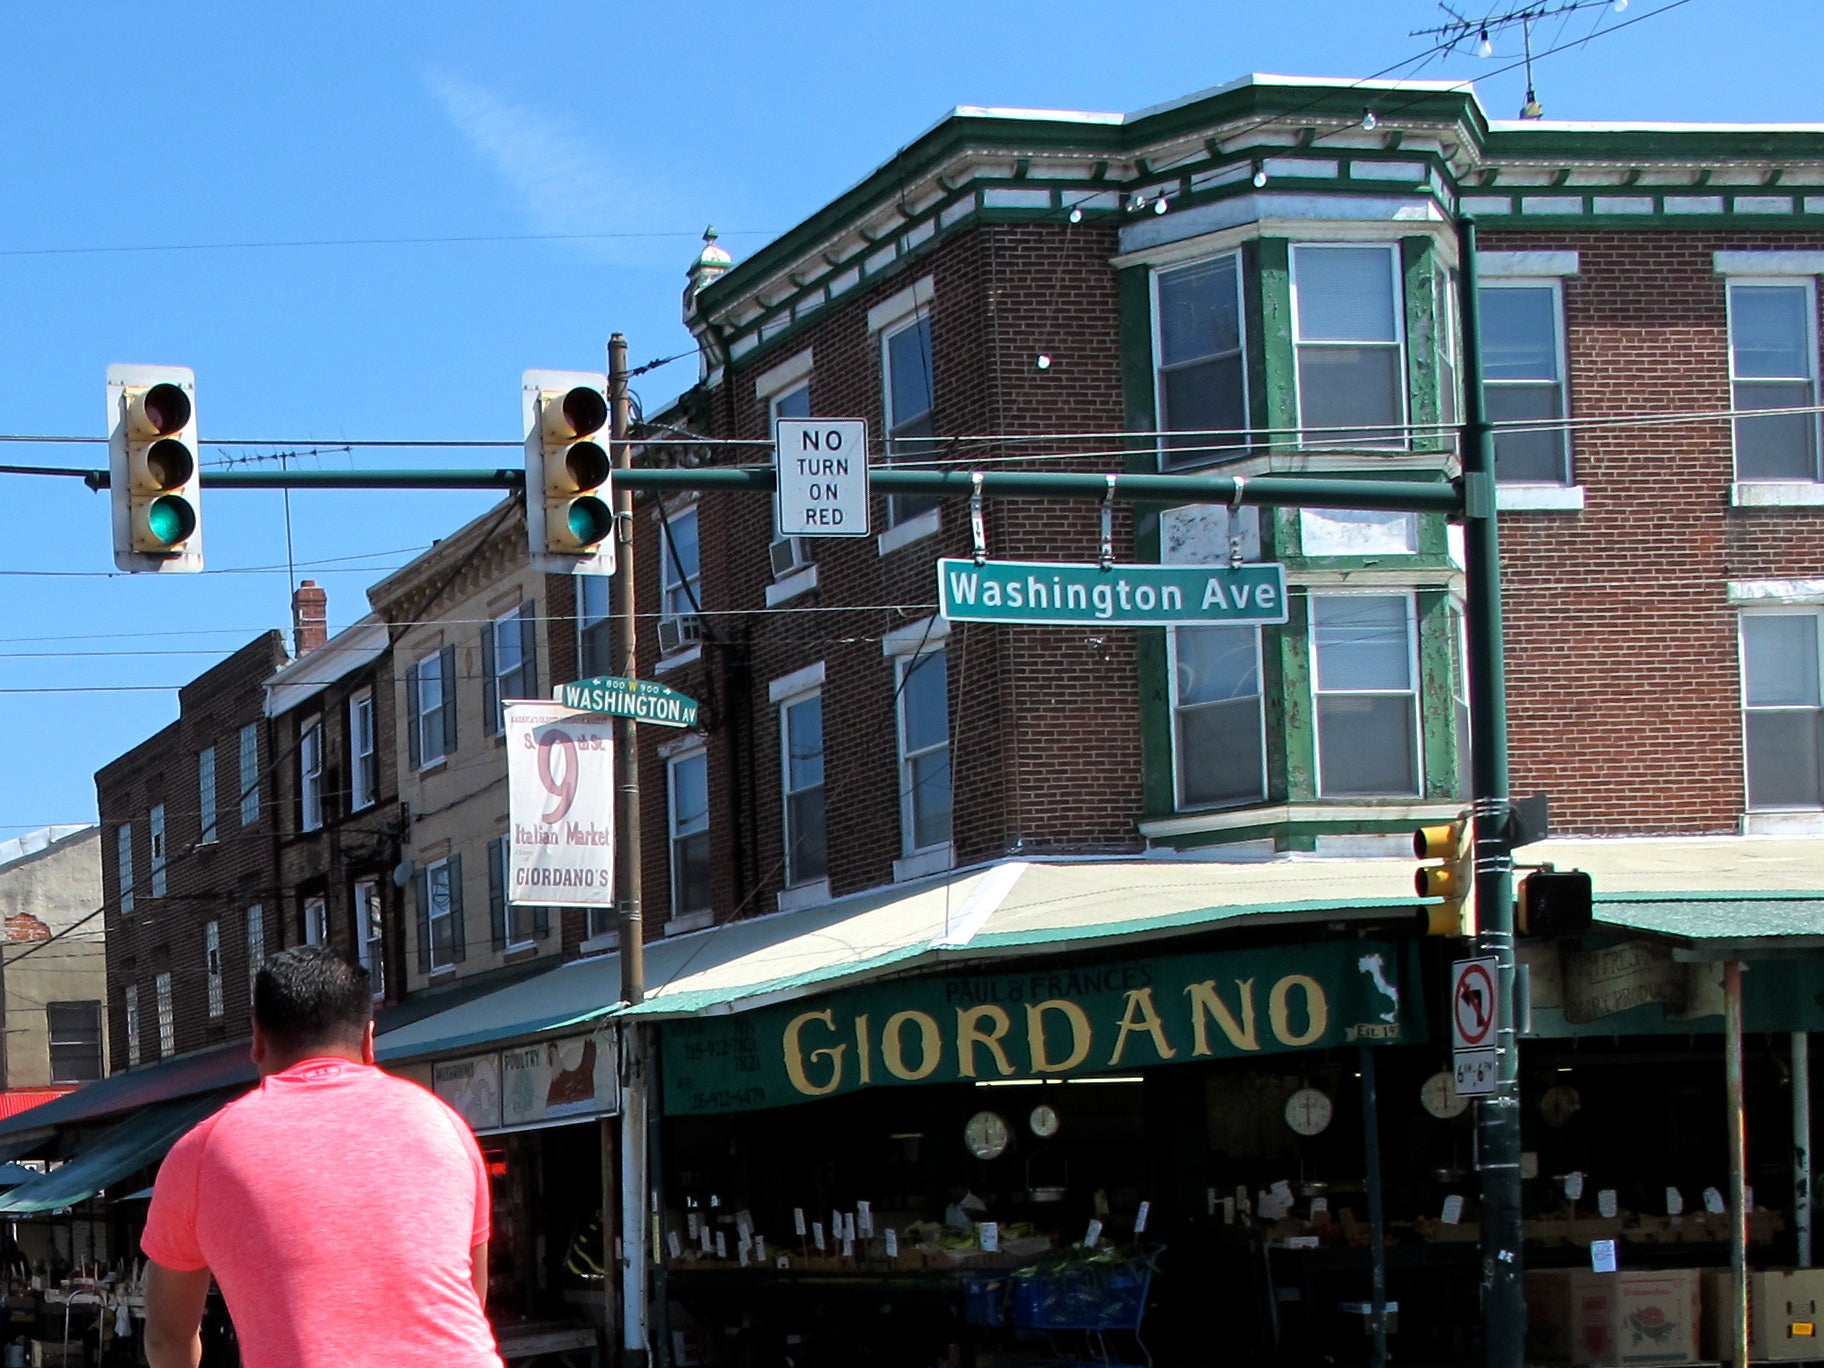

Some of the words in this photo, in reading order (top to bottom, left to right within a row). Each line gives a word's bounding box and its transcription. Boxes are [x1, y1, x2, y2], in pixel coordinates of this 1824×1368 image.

[802, 430, 842, 451] NO
[797, 459, 848, 475] TURN
[810, 483, 838, 500] ON
[806, 509, 843, 525] RED
[949, 571, 1181, 619] Washington
[1201, 578, 1276, 611] Ave
[628, 682, 637, 691] W
[640, 684, 659, 694] 900
[566, 686, 680, 721] WASHINGTON
[682, 708, 696, 722] AV
[515, 823, 558, 845] Italian
[566, 821, 609, 846] Market
[516, 867, 608, 887] GIORDANO'S
[945, 980, 1003, 1003] PAUL
[1030, 964, 1152, 998] FRANCES
[783, 974, 1328, 1096] GIORDANO
[504, 1050, 539, 1071] POULTRY
